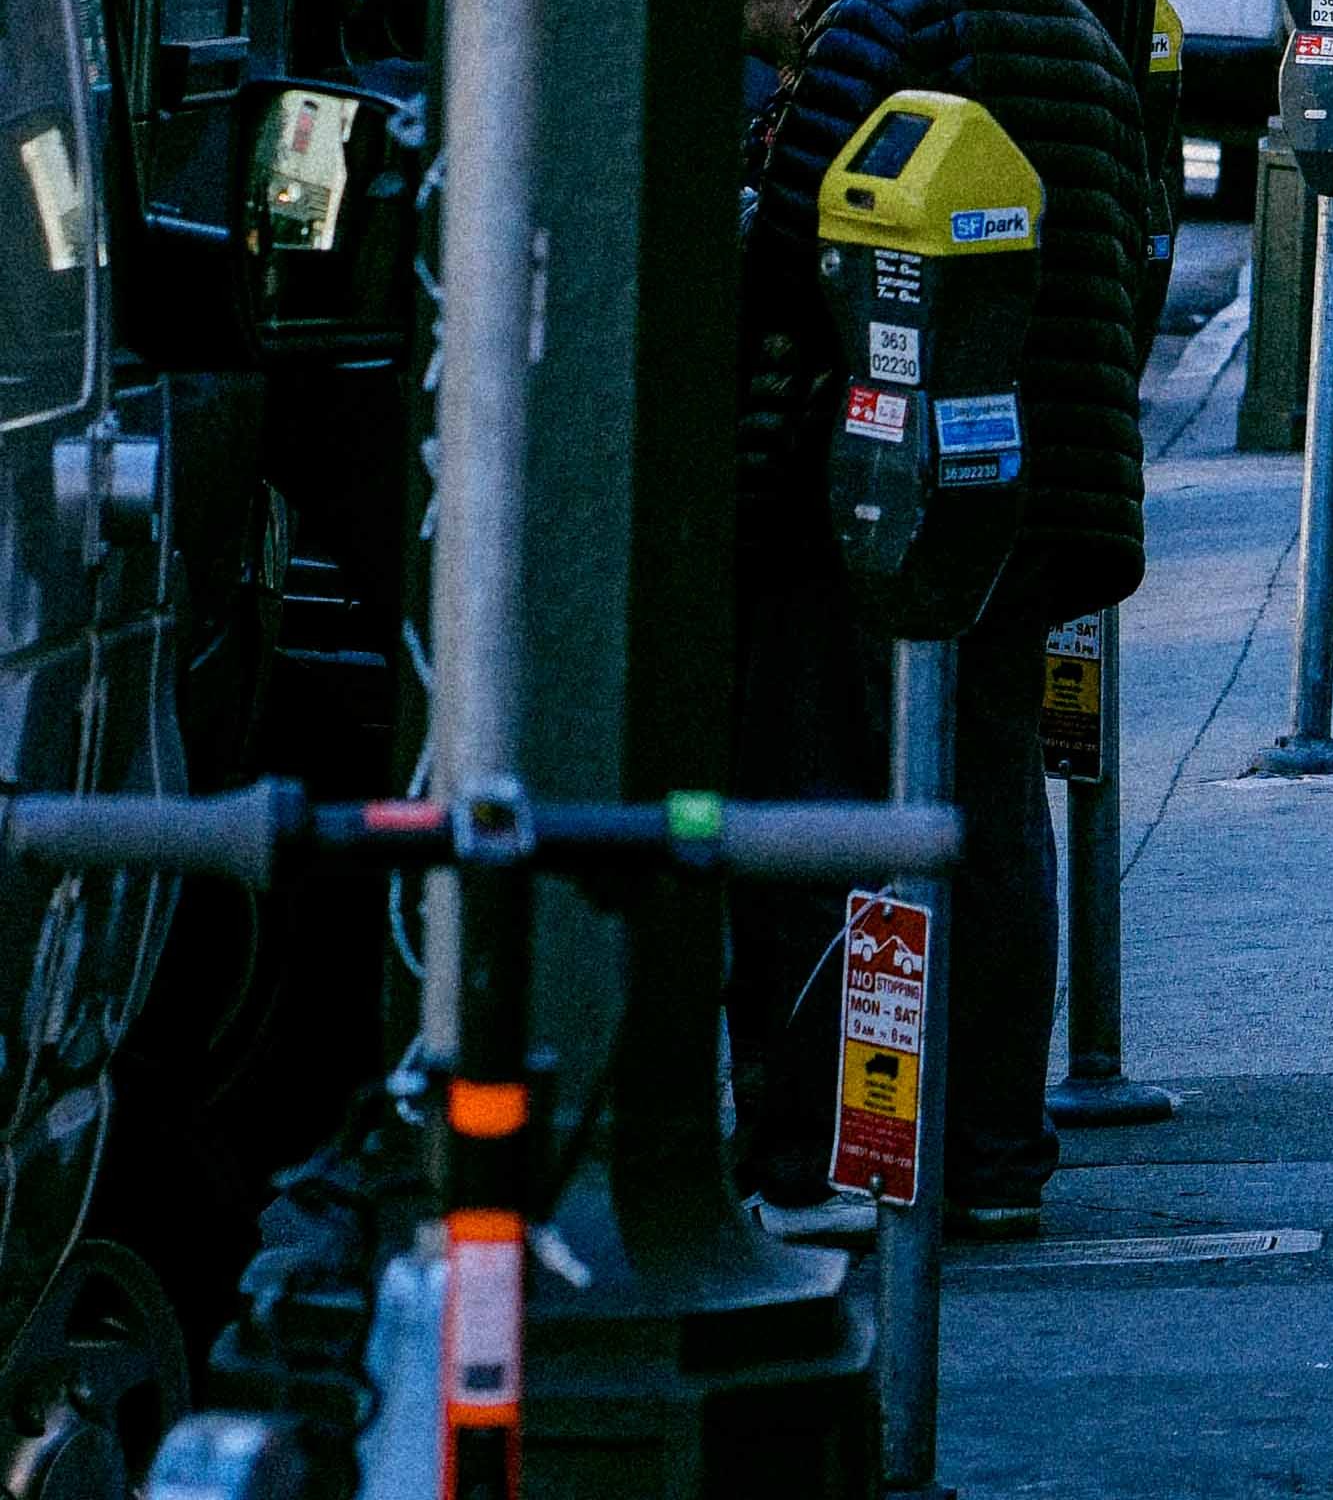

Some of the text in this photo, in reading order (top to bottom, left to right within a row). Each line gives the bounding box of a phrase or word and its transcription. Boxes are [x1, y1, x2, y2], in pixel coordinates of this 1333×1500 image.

[880, 330, 908, 352] 363
[871, 353, 917, 378] 02230
[851, 970, 921, 999] NO STOPPING
[850, 994, 880, 1018] MON
[894, 1005, 919, 1026] SAT
